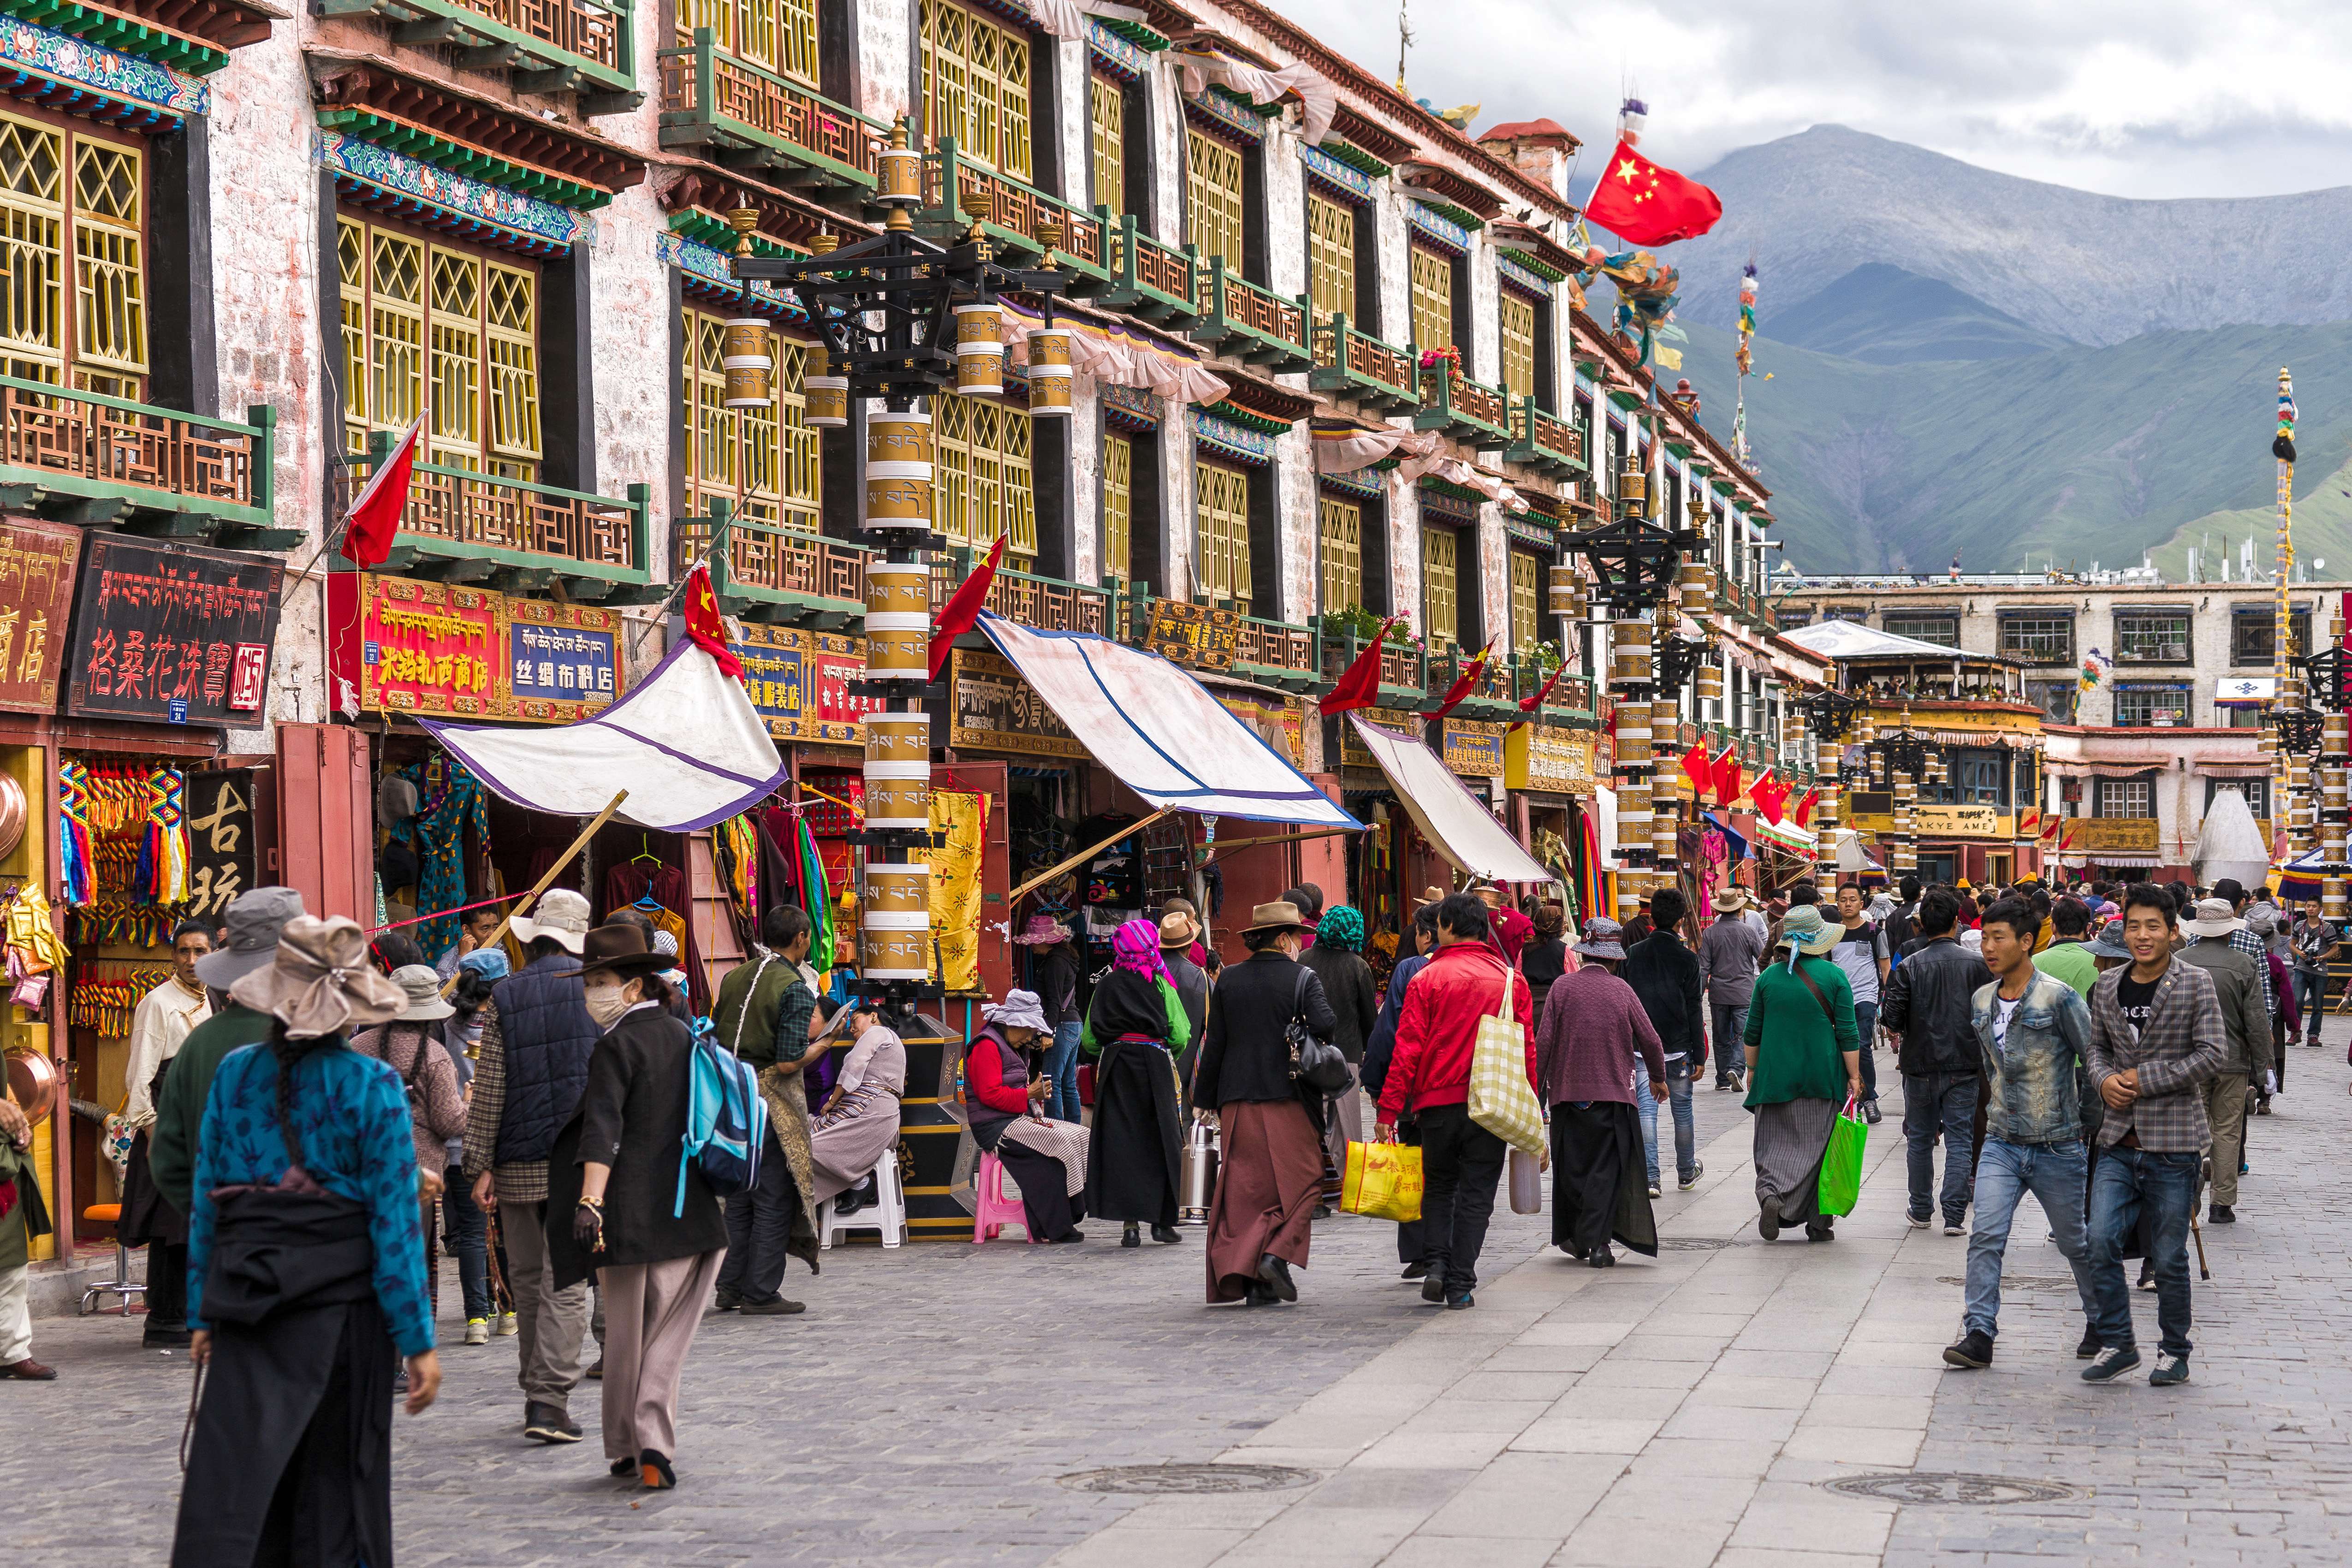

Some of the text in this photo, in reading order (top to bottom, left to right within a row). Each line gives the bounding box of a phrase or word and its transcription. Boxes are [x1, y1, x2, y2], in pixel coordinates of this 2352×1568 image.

[379, 645, 488, 694] 米玛扎西商店
[516, 659, 613, 691] 丝绸布料店
